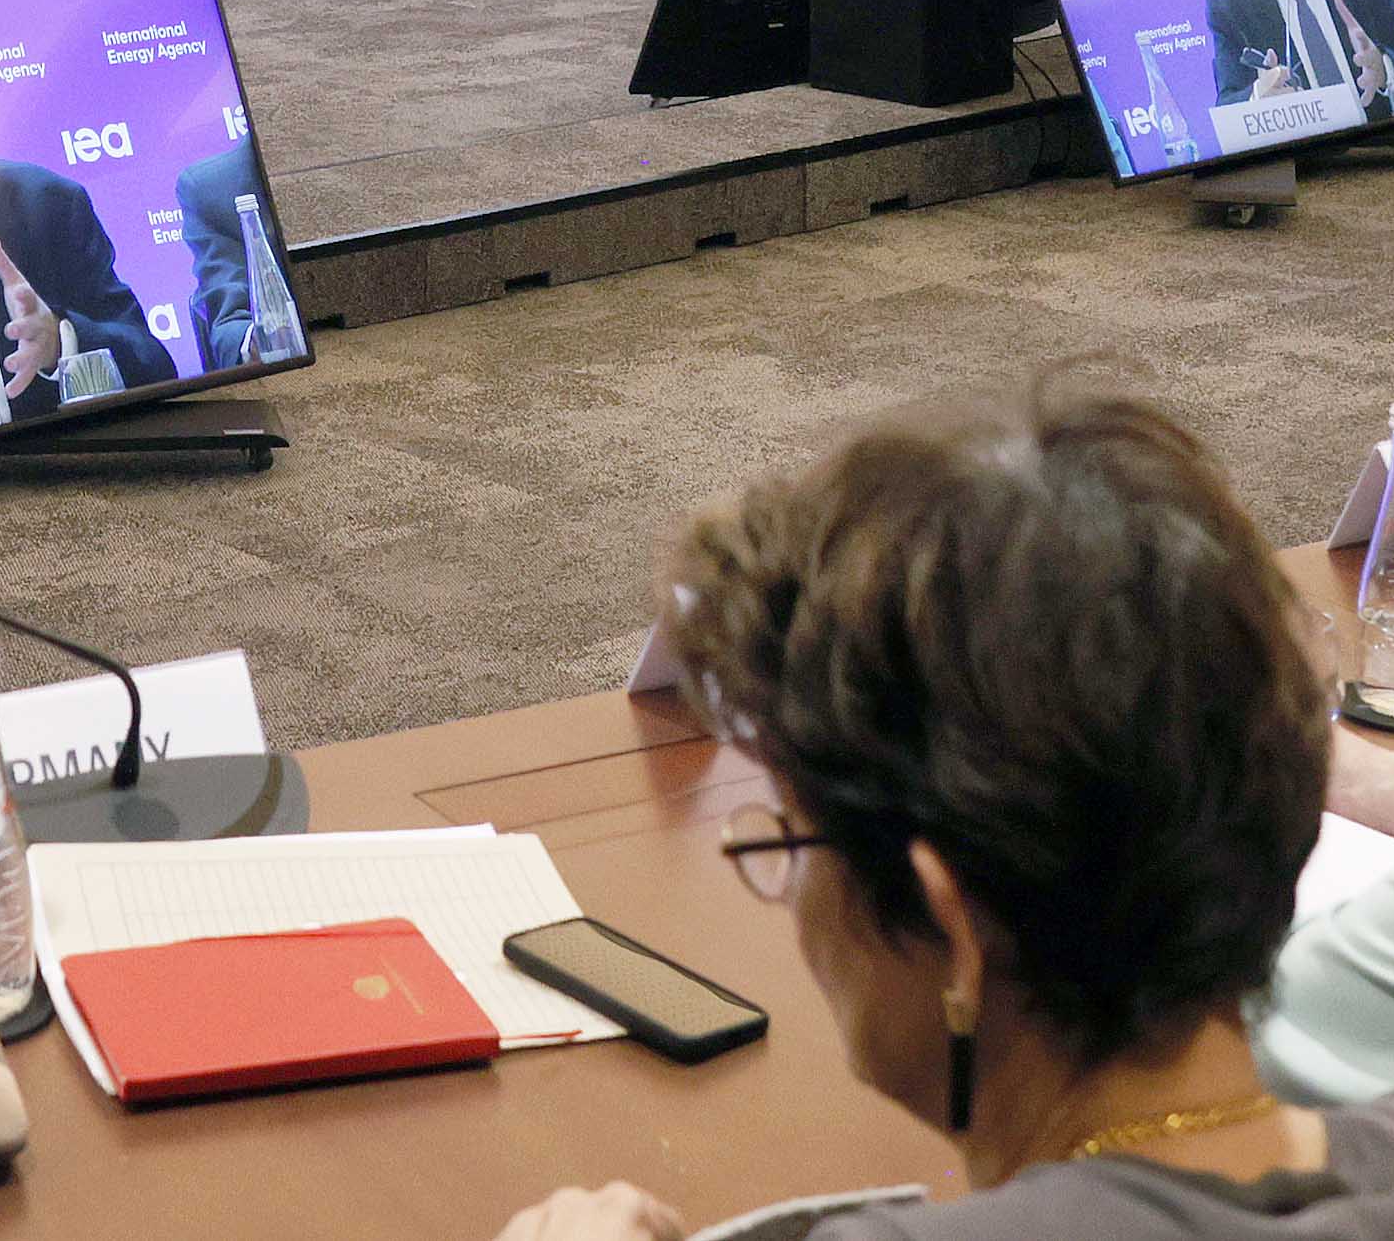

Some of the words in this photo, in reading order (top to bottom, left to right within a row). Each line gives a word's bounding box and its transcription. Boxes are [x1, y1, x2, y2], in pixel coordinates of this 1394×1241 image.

[103, 21, 187, 46] International
[1175, 35, 1205, 52] Agency
[107, 49, 155, 65] Energy
[158, 40, 206, 61] Agency
[1081, 55, 1106, 72] gency
[1244, 101, 1328, 136] EXECUTIVE
[61, 122, 133, 166] iea
[153, 229, 183, 245] Ener
